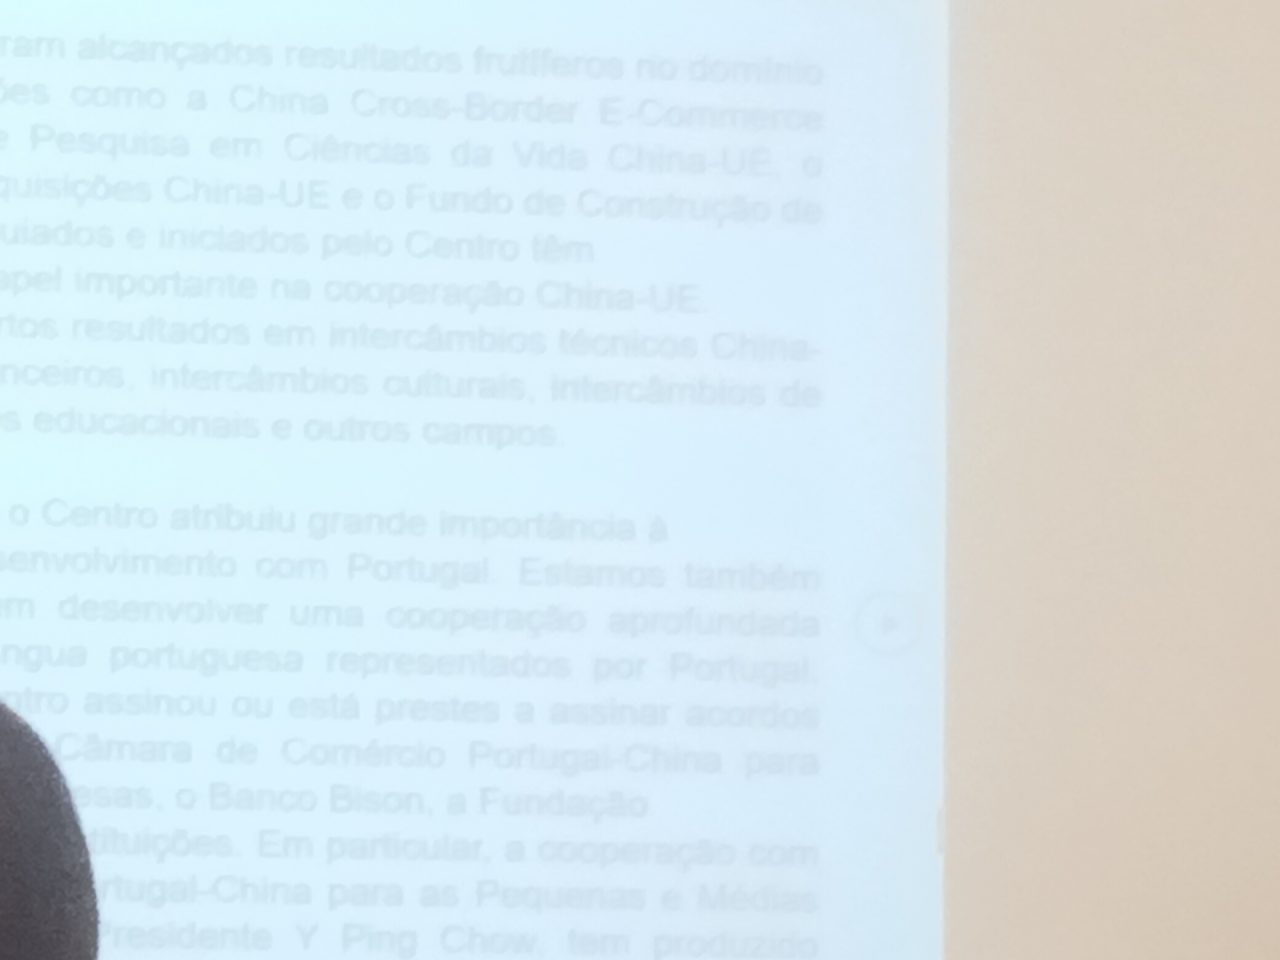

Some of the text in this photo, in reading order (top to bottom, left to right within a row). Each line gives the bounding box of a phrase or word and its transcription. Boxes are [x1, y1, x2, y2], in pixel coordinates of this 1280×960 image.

[77, 34, 273, 71] alcançados
[285, 44, 463, 74] resultados
[636, 57, 679, 81] no
[687, 56, 824, 86] domínio
[70, 86, 167, 110] como
[186, 89, 208, 110] a
[229, 84, 329, 116] China
[351, 88, 578, 124] Cross-Border
[599, 97, 823, 133] E-Commerce
[29, 124, 190, 161] Pesquisa
[209, 136, 262, 158] em
[283, 132, 430, 166] Ciências
[450, 140, 493, 168] da
[513, 140, 588, 172] Vida
[801, 155, 823, 178] o
[164, 175, 330, 209] China-UE
[341, 187, 363, 210] e
[373, 188, 395, 211] o
[405, 182, 514, 214] Fundo
[523, 190, 567, 216] de
[576, 188, 772, 228] Construção
[781, 199, 823, 224] de
[125, 226, 147, 250] e
[158, 223, 310, 256] iniciados
[321, 228, 394, 261] pelo
[404, 229, 520, 262] Centro
[532, 234, 595, 263] têm
[74, 268, 258, 302] importante
[272, 277, 311, 302] na
[323, 279, 525, 314] cooperação
[72, 315, 250, 345] resultados
[264, 323, 315, 347] em
[328, 321, 547, 355] intercâmbios
[558, 327, 699, 360] técnicos
[711, 331, 823, 362] China-
[151, 362, 369, 396] intercâmbios
[551, 373, 767, 408] intercâmbios
[778, 378, 823, 408] de
[33, 406, 261, 440] educacionais
[271, 417, 293, 441] e
[303, 415, 411, 443] outros
[8, 497, 669, 544] o Centro atribuiu grande importância à
[255, 556, 328, 580] com
[518, 557, 667, 588] Estamos
[684, 561, 820, 591] também
[57, 593, 269, 624] desenvolver
[290, 604, 364, 627] uma
[384, 604, 587, 638] cooperação
[607, 606, 822, 638] aprofundada
[109, 643, 305, 677] portuguesa
[326, 649, 572, 681] representados
[593, 655, 648, 686] por
[84, 690, 217, 716] assinou
[231, 695, 274, 719] ou
[287, 691, 361, 721] está
[374, 698, 501, 726] prestes
[514, 702, 535, 724] a
[549, 701, 671, 728] assinar
[685, 702, 821, 730] acordos
[55, 732, 821, 781] Câmara de Comércio Portugal-China para
[174, 787, 197, 811] o
[209, 781, 318, 813] Banco
[446, 792, 468, 816] a
[478, 786, 650, 825] Fundação
[258, 828, 315, 859] Em
[504, 840, 526, 863] a
[537, 838, 738, 875] cooperação
[748, 842, 820, 867] com
[327, 882, 405, 911] para
[419, 884, 460, 908] as
[475, 878, 647, 914] Pequenas
[660, 889, 683, 912] e
[699, 883, 822, 914] Médias
[295, 923, 320, 951] Y
[340, 922, 419, 960] Ping
[567, 928, 631, 956] tem
